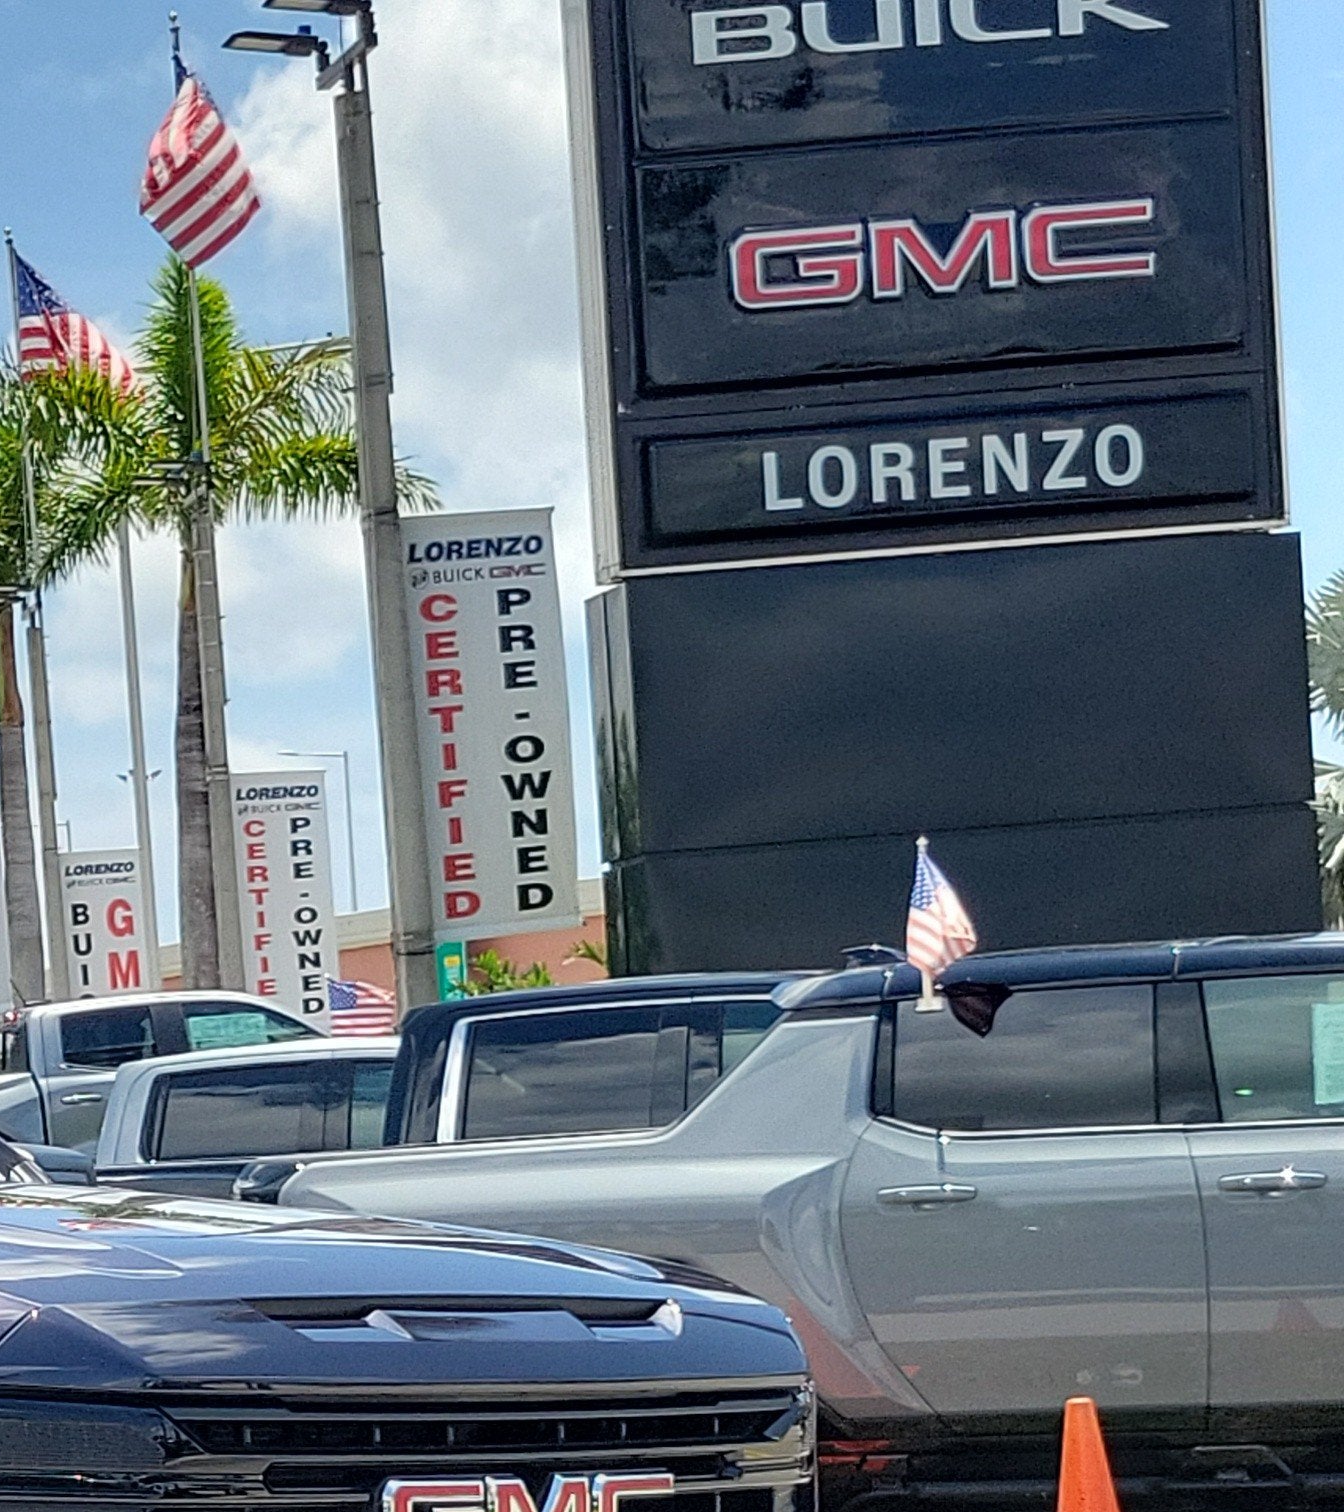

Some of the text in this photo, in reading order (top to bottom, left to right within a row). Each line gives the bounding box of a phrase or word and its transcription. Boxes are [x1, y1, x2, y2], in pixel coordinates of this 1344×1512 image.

[692, 0, 1169, 64] BUICK
[731, 198, 1156, 310] GMC
[762, 425, 1145, 512] LORENZO
[407, 535, 543, 564] LORENZO
[433, 563, 546, 584] BUICK GMC
[236, 785, 318, 801] LORENZO
[419, 592, 481, 920] CERTIFIED
[496, 588, 554, 912] PRE-OWNED
[65, 862, 134, 876] LORENZO
[71, 903, 94, 999] BUI
[290, 817, 324, 1013] PRE-OWNED
